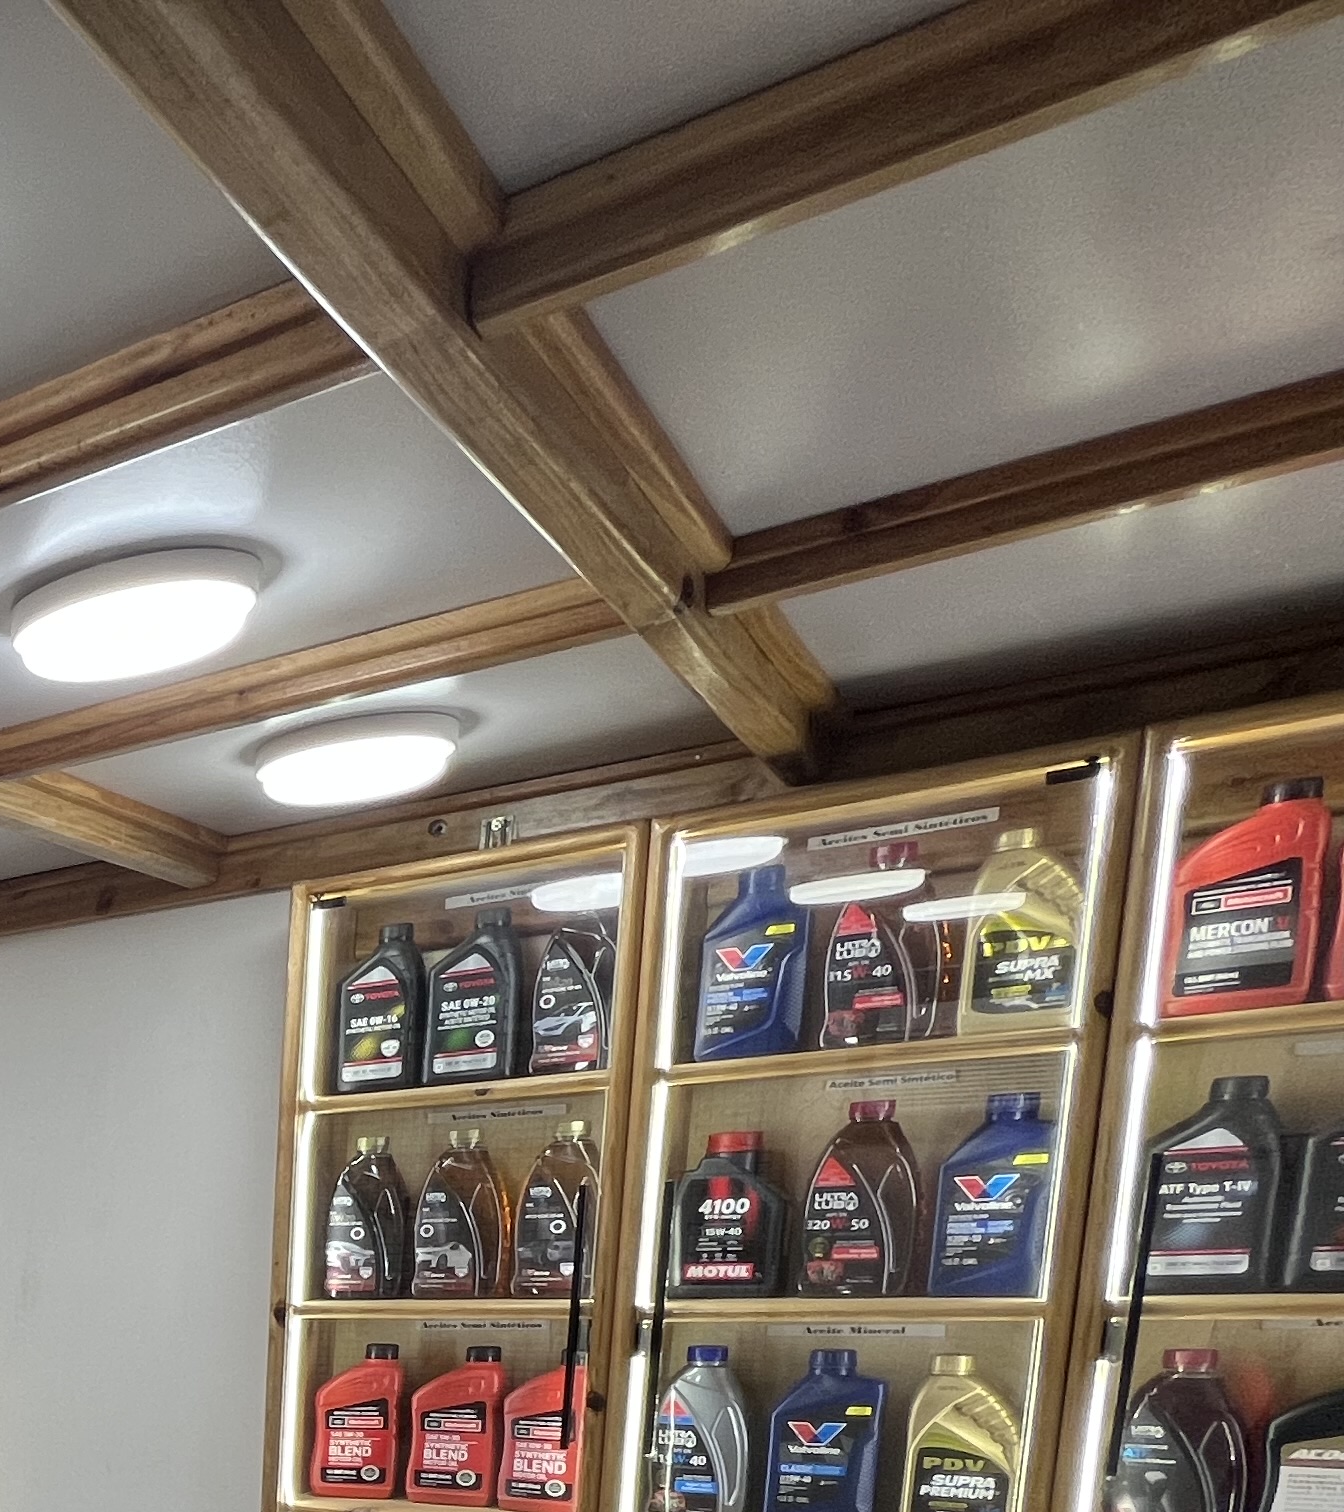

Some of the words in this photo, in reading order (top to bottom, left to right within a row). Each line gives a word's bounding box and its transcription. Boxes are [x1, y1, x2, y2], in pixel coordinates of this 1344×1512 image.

[1190, 918, 1270, 941] MERCON
[995, 955, 1060, 974] SUPRA
[441, 1000, 461, 1012] SAE
[463, 996, 496, 1010] 0W-20
[350, 1016, 368, 1028] SAE
[370, 1014, 399, 1027] 0W-16
[829, 1081, 864, 1089] Aceite
[868, 1078, 897, 1087] Semi
[1191, 1159, 1249, 1171] TOYOTA
[1159, 1183, 1185, 1195] ATF
[1188, 1182, 1220, 1195] Type
[1223, 1180, 1252, 1192] T-IV
[698, 1198, 750, 1215] 4100
[686, 1265, 749, 1278] MOTUL
[329, 1446, 372, 1458] BLEND
[424, 1449, 468, 1462] BLEND
[515, 1450, 567, 1461] SYNTHETIC
[513, 1459, 567, 1474] BLEND
[923, 1457, 986, 1471] PDV
[930, 1474, 996, 1489] SUPRA
[920, 1485, 995, 1500] PREMIUM
